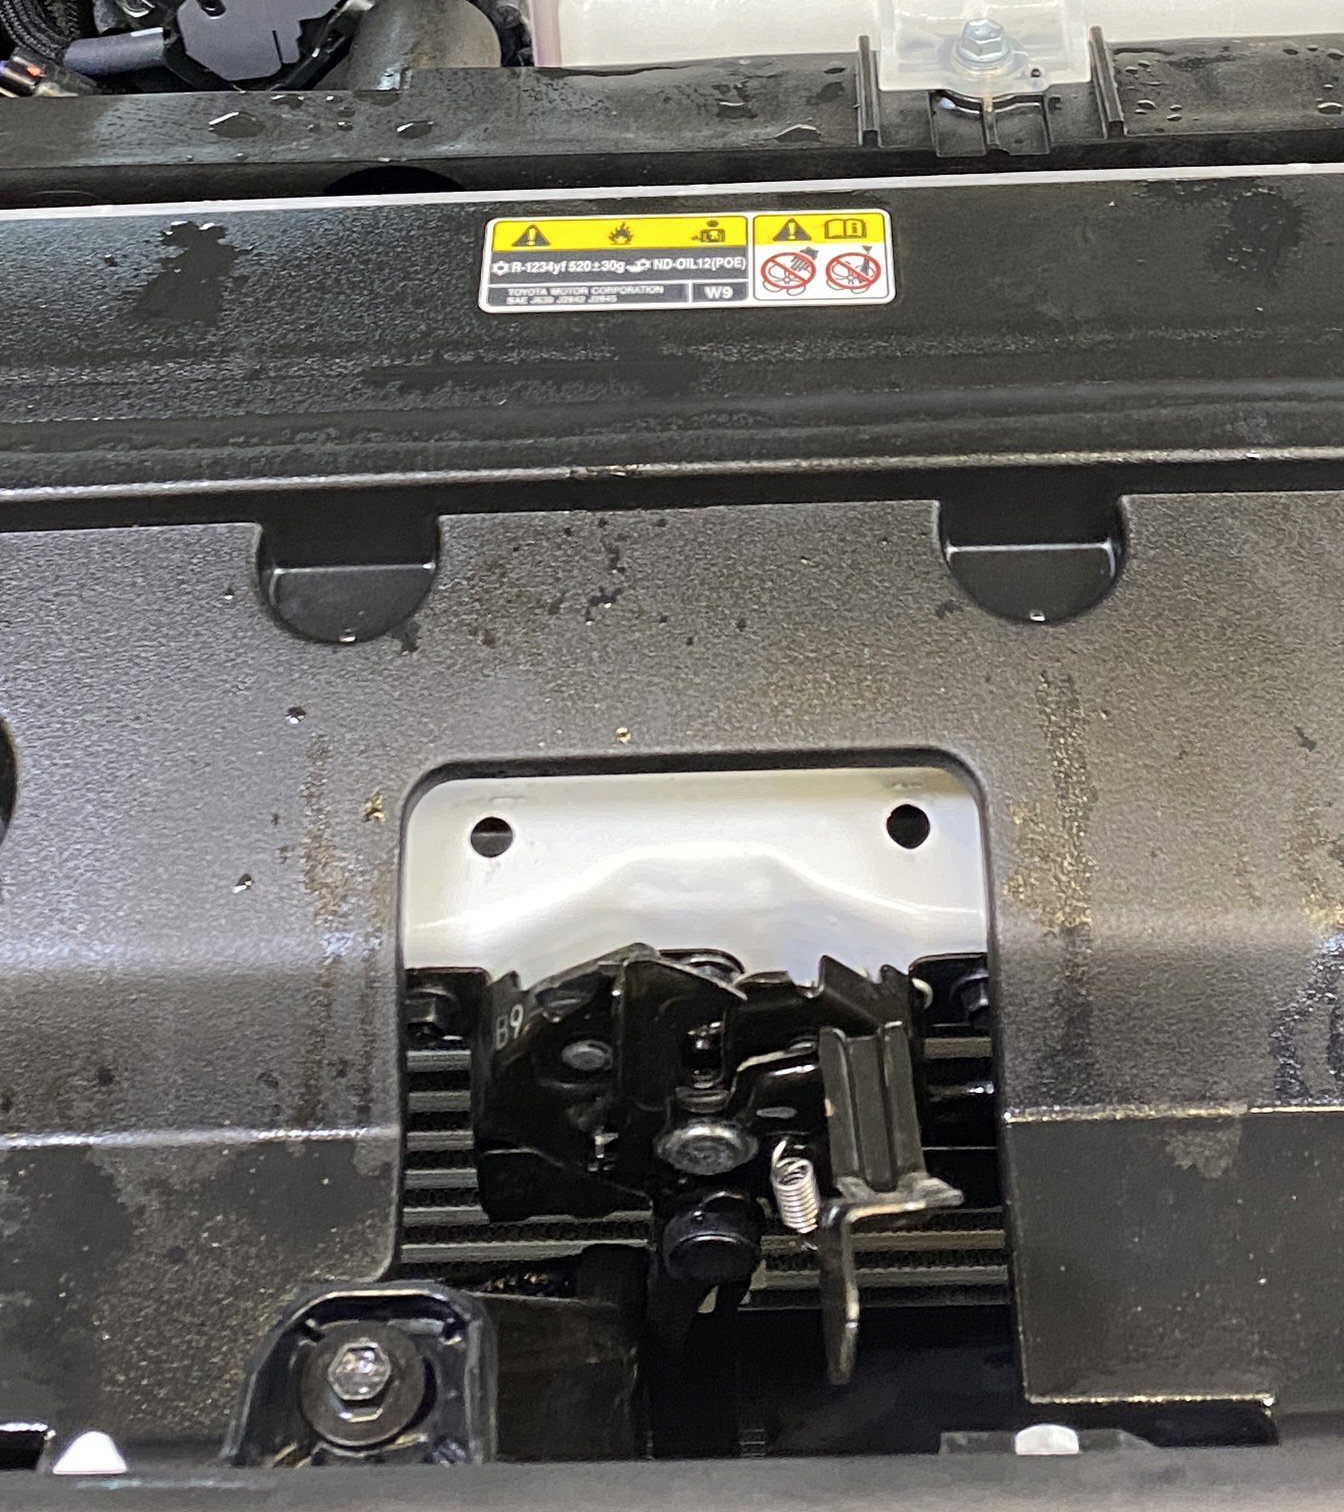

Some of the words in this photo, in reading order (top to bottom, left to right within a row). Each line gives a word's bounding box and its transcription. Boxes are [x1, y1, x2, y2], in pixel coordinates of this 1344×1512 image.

[512, 259, 567, 275] R-1234yf
[568, 259, 626, 274] 520±30g
[652, 256, 747, 271] ND-OIL12(POE)
[507, 288, 549, 296] TOYOTA
[549, 287, 589, 296] MOTOR
[590, 285, 665, 295] CORPORATION
[703, 285, 734, 300] W9
[505, 296, 529, 305] SAE
